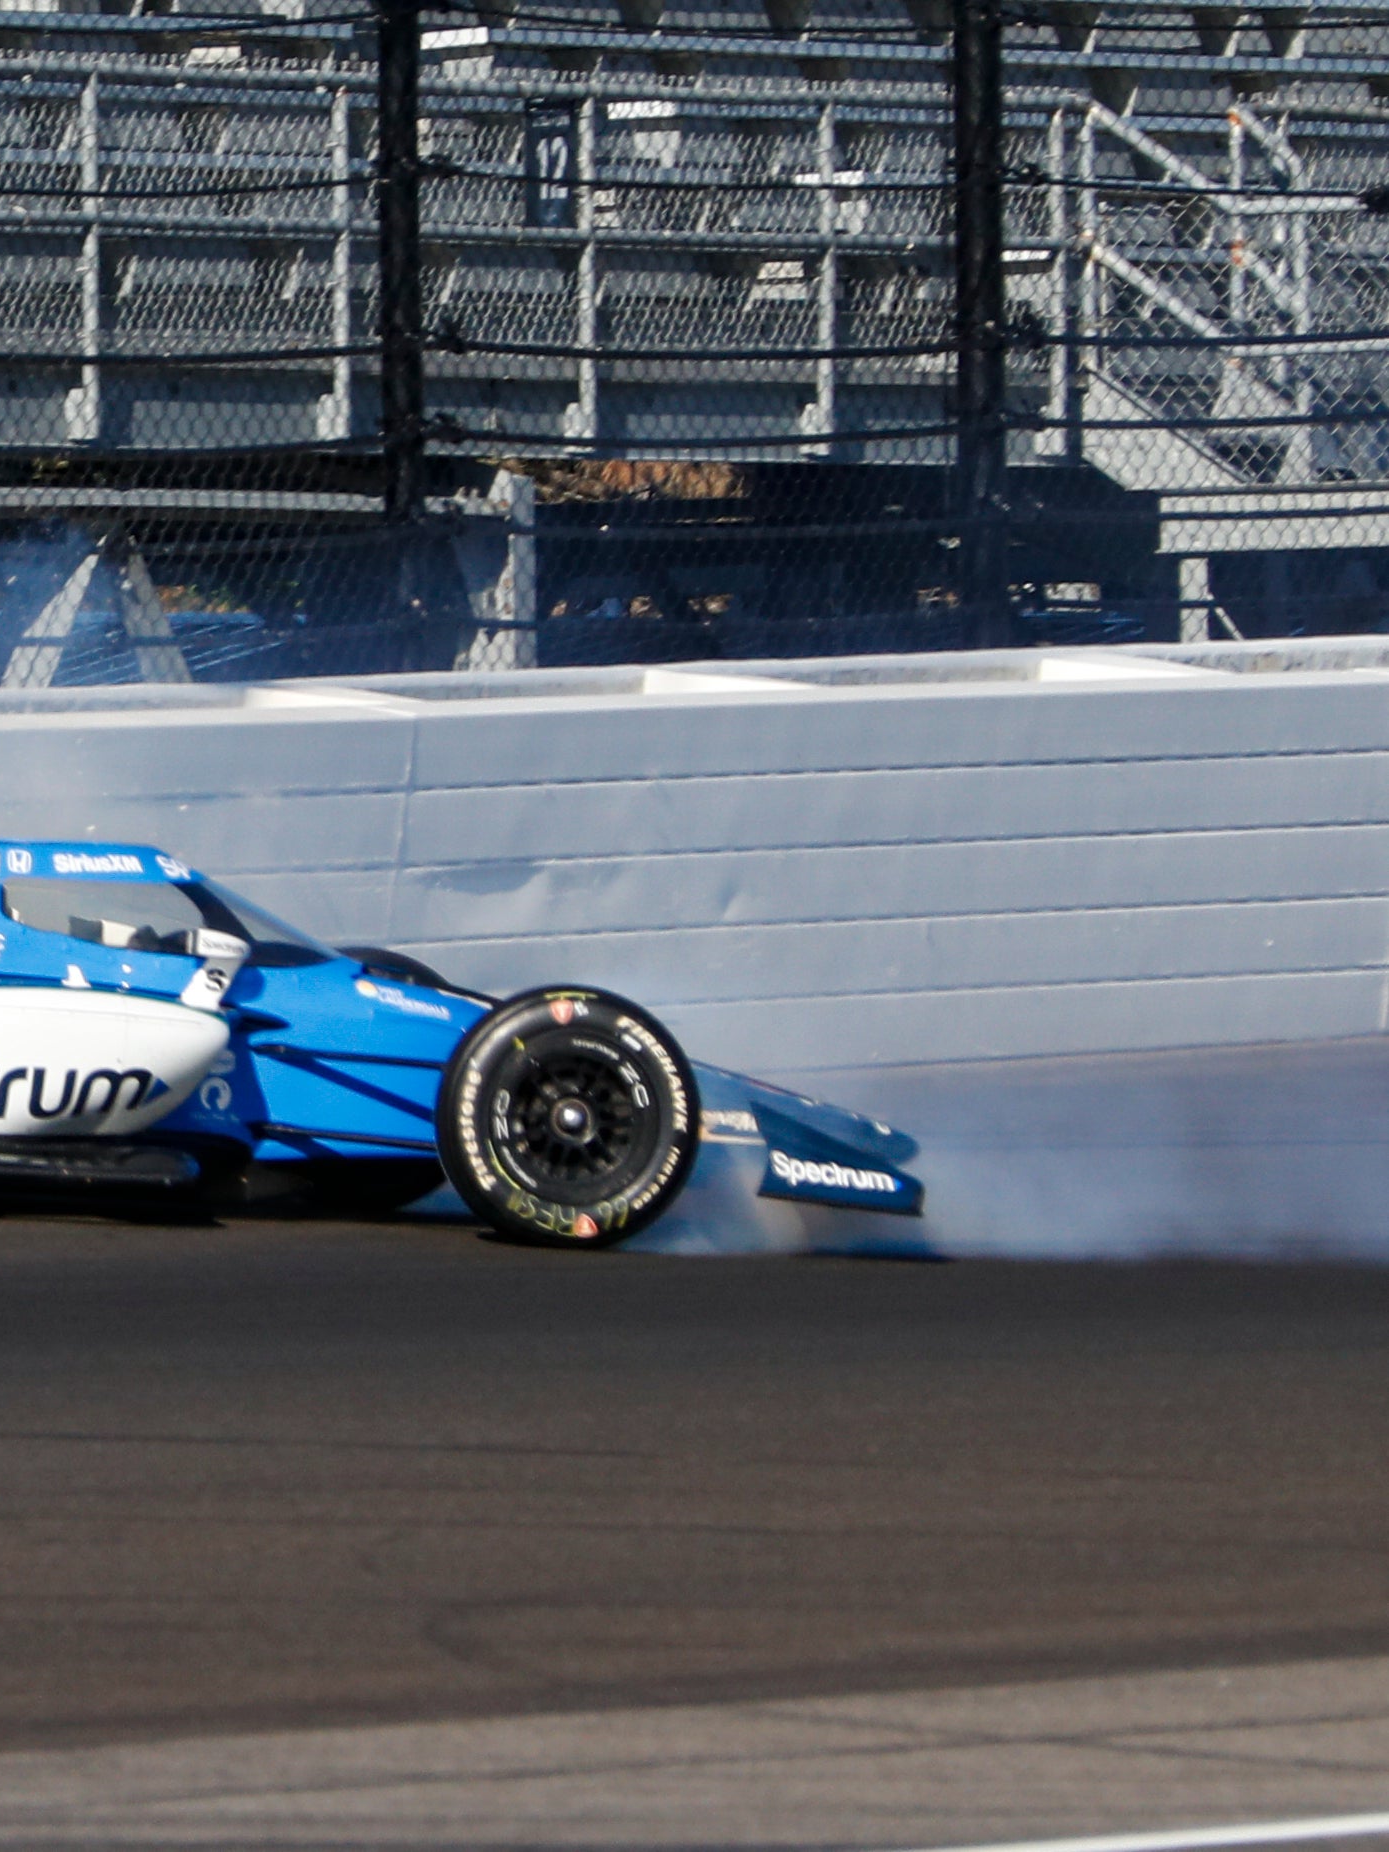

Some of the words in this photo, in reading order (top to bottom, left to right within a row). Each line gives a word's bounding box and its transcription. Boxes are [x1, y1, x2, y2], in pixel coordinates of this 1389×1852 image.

[536, 136, 569, 199] 12
[53, 853, 144, 874] SiriusXM
[616, 1015, 688, 1133] FIREHAWK
[460, 1068, 497, 1192] Firestone
[770, 1150, 896, 1193] Spectrum
